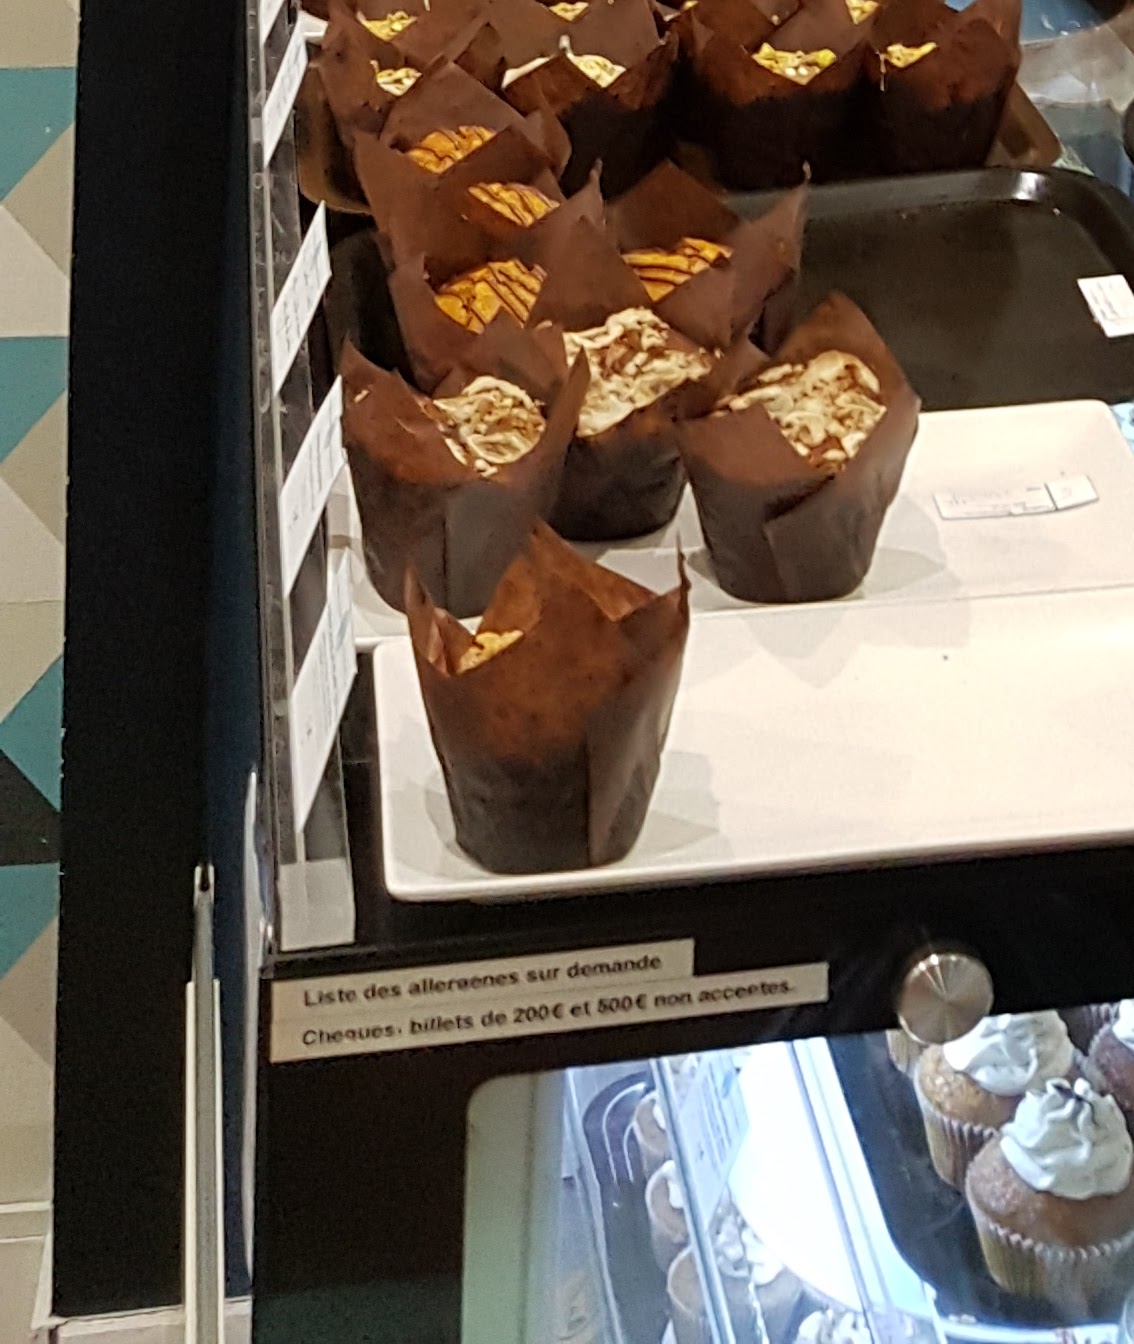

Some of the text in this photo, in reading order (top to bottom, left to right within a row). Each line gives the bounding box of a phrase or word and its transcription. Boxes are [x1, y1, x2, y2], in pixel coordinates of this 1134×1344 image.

[303, 985, 358, 1008] Liste
[362, 981, 403, 1001] des
[525, 965, 561, 981] sur
[566, 954, 662, 980] demande
[408, 1013, 475, 1036] billets
[479, 1009, 509, 1026] de
[512, 1001, 566, 1025] 200€
[569, 999, 593, 1017] et
[598, 993, 648, 1014] 500€
[653, 989, 694, 1009] non
